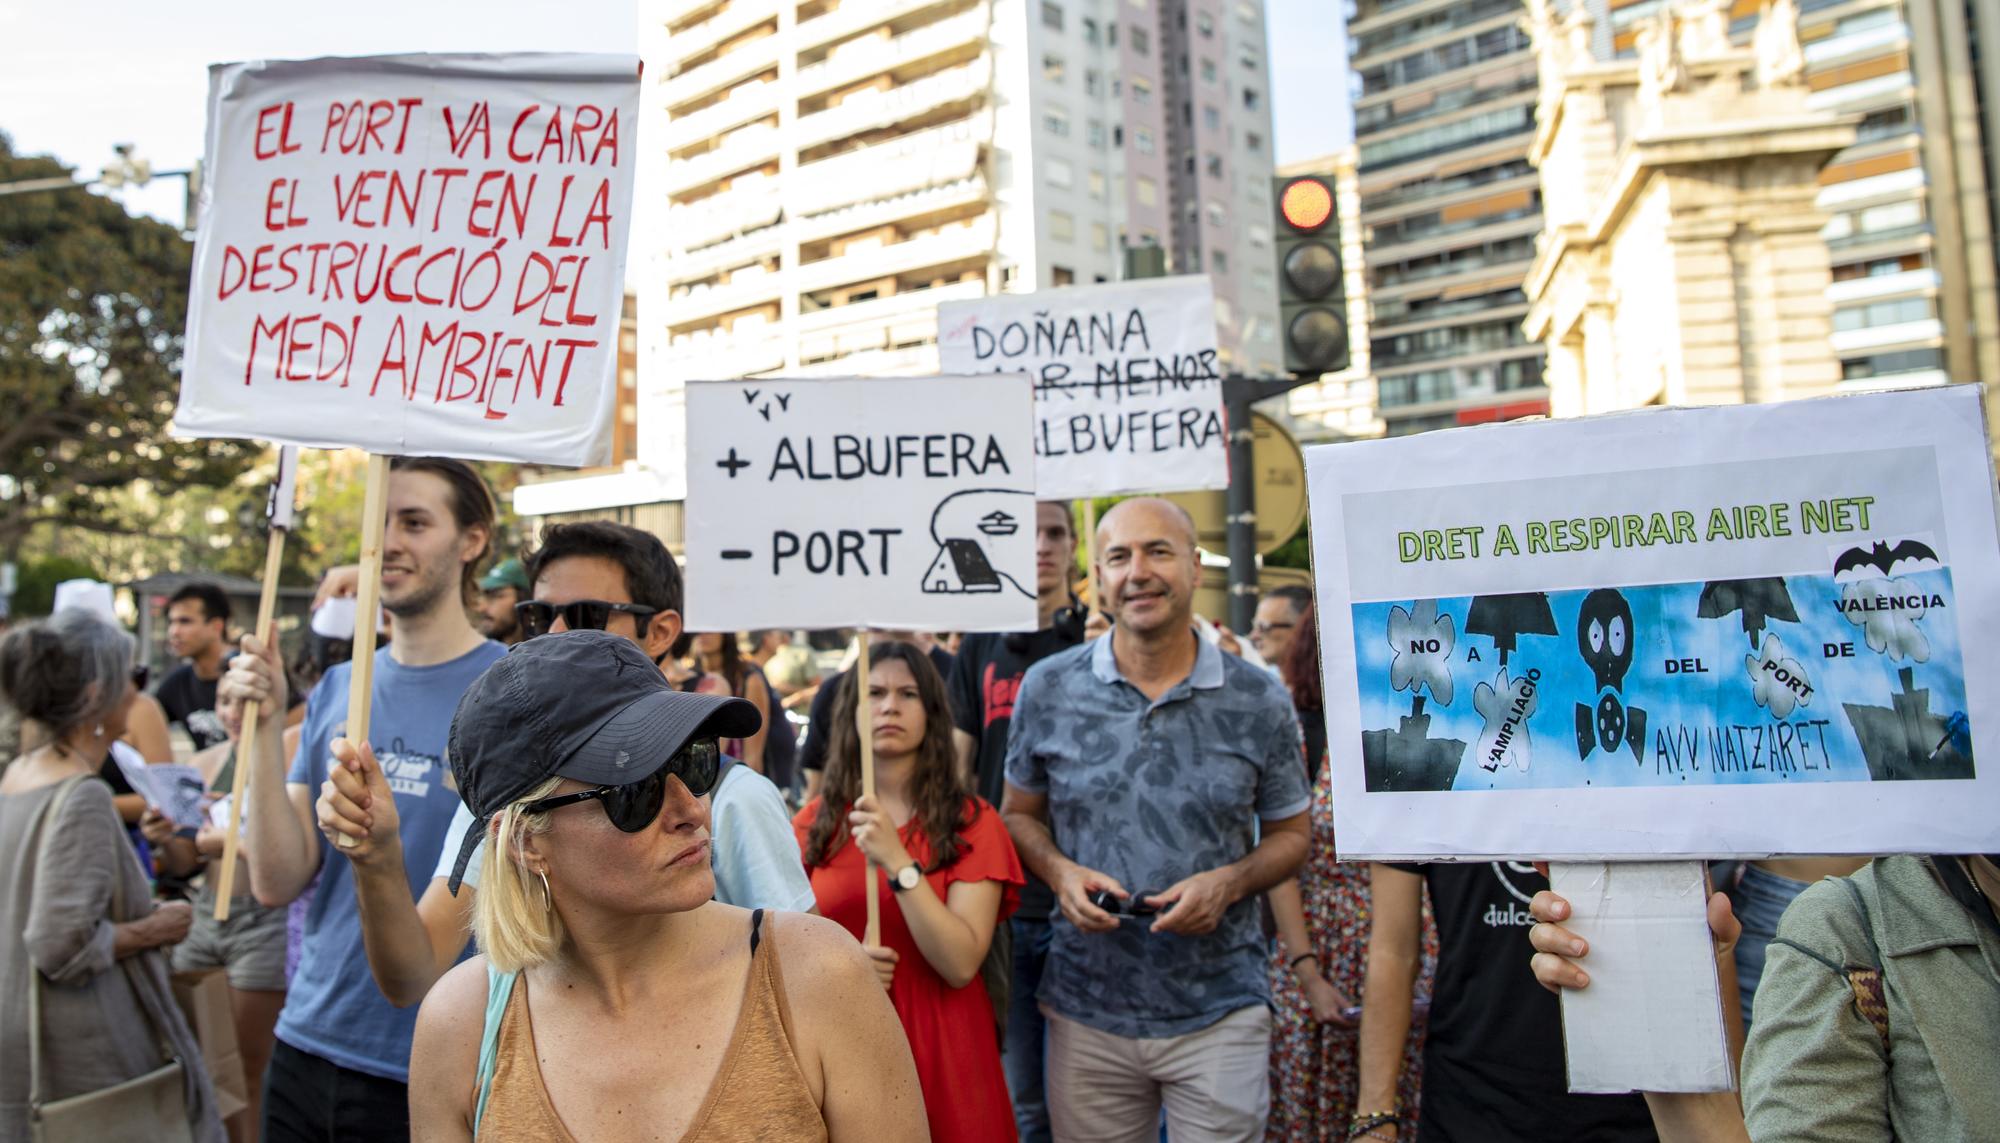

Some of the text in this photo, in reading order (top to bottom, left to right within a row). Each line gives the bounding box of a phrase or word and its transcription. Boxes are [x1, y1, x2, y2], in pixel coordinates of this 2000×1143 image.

[254, 97, 619, 167] EL PORT VA CARA
[265, 168, 613, 250] EL VENT EN LA
[218, 236, 597, 326] DESTRUCCIÓ DEL
[972, 308, 1150, 360] DOÑANA
[244, 311, 599, 421] MEDI AMBIENT
[1095, 349, 1220, 405] MENOR
[768, 432, 1011, 481] ALBUFERA
[772, 528, 903, 577] PORT
[1397, 495, 1876, 564] DRET A RESPIRAR AIRE NET
[1832, 593, 1946, 613] VALÈNCIA
[1410, 639, 1441, 654] NO
[1466, 646, 1482, 663] A
[1664, 657, 1709, 674] DEL
[1822, 641, 1856, 659] DE
[1761, 659, 1814, 699] PORT
[1708, 719, 1832, 778] NATZARET
